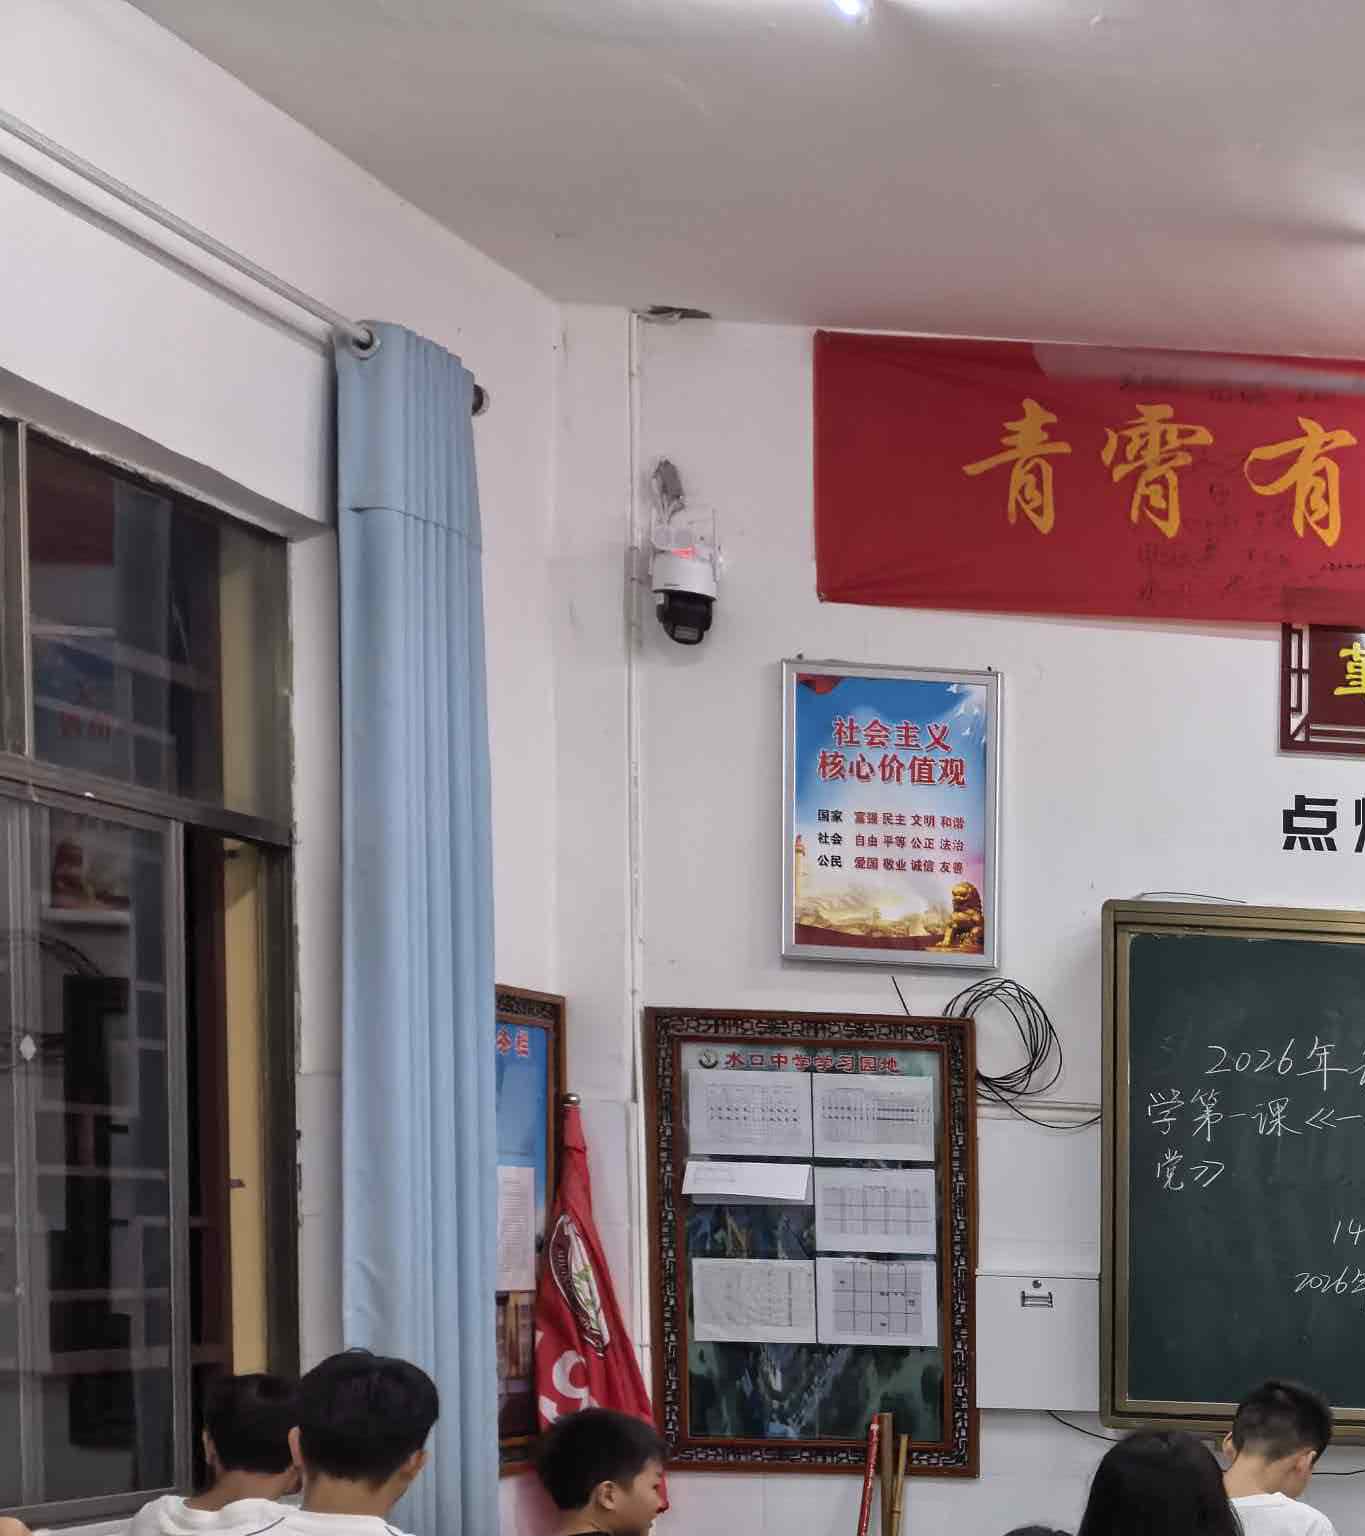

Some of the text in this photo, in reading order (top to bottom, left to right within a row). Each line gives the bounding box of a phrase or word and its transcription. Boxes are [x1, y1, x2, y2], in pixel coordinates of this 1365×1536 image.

[832, 715, 953, 752] 社会主义
[817, 751, 968, 788] 核心价值观
[817, 809, 843, 823] 国家
[882, 812, 906, 826] 民主
[911, 814, 935, 828] 文明
[940, 816, 964, 830] 和谐
[817, 832, 964, 851] 社会 自由 平等 公正 法治
[817, 854, 964, 874] 公民 爱国 敬业 诚信 友善
